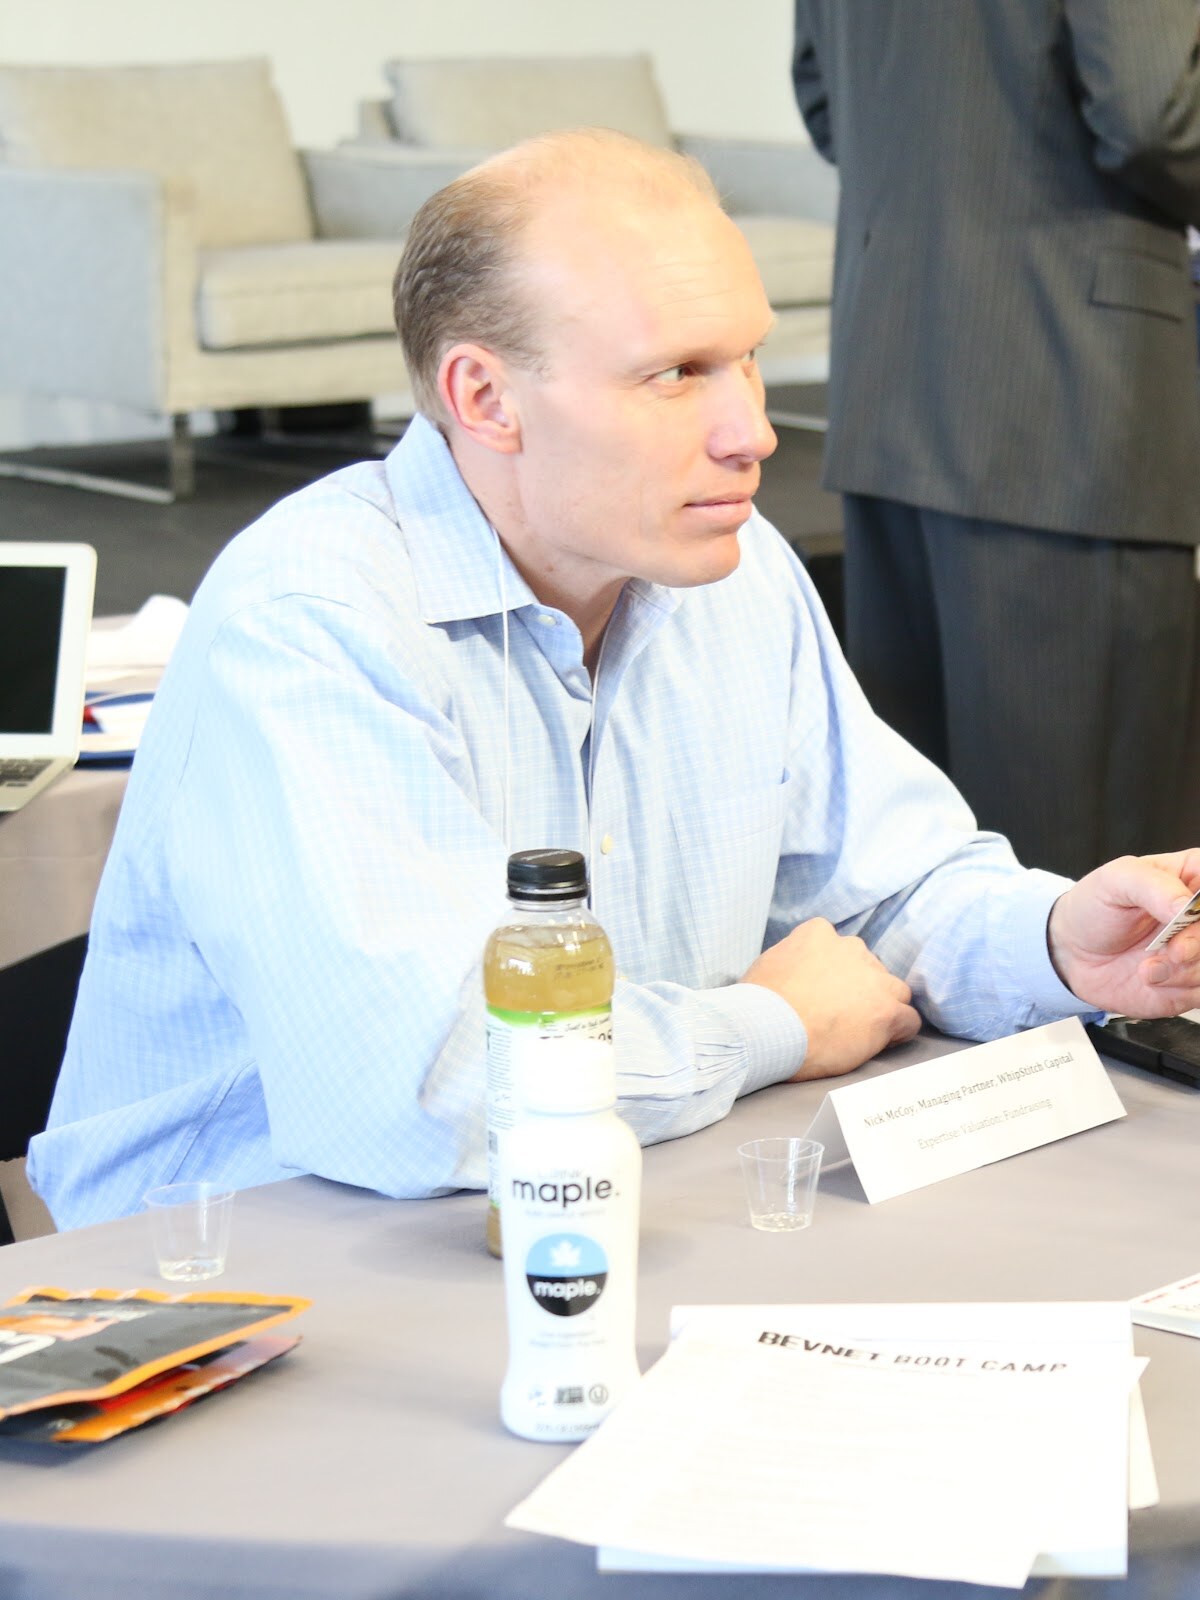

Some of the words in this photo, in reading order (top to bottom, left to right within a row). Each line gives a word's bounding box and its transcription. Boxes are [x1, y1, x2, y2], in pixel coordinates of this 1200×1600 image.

[864, 1113, 885, 1129] Nick
[885, 1105, 918, 1123] McCoy,
[917, 1090, 962, 1112] Managing
[960, 1078, 999, 1099] Partner,
[996, 1060, 1045, 1086] WhipStitch
[1044, 1051, 1075, 1071] Capital
[917, 1129, 961, 1151] Expertise:
[757, 1330, 882, 1361] BEVNET
[894, 1353, 967, 1369] BOOT
[980, 1358, 1069, 1373] CAMP
